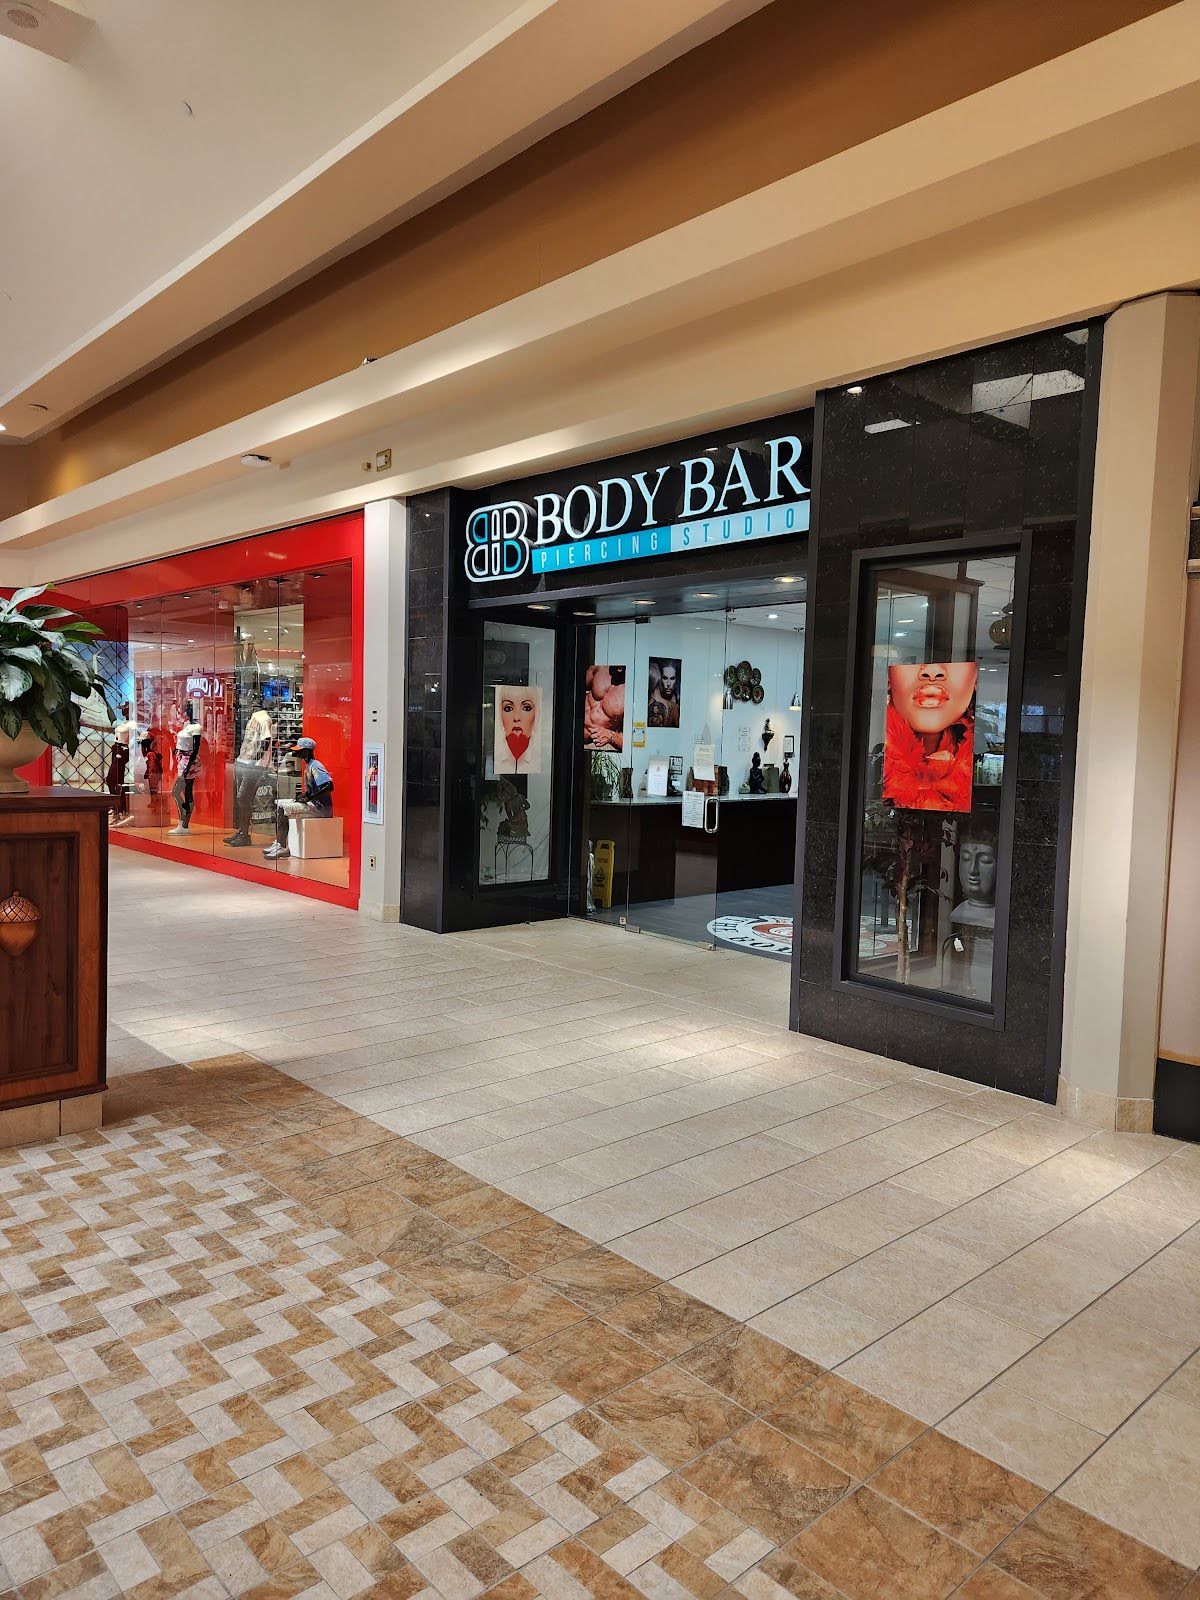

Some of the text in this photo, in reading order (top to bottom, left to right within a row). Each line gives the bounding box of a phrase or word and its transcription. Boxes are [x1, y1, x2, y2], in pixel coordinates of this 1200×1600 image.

[534, 435, 811, 545] BODY BAR
[541, 507, 795, 569] PIERCING STUDIO
